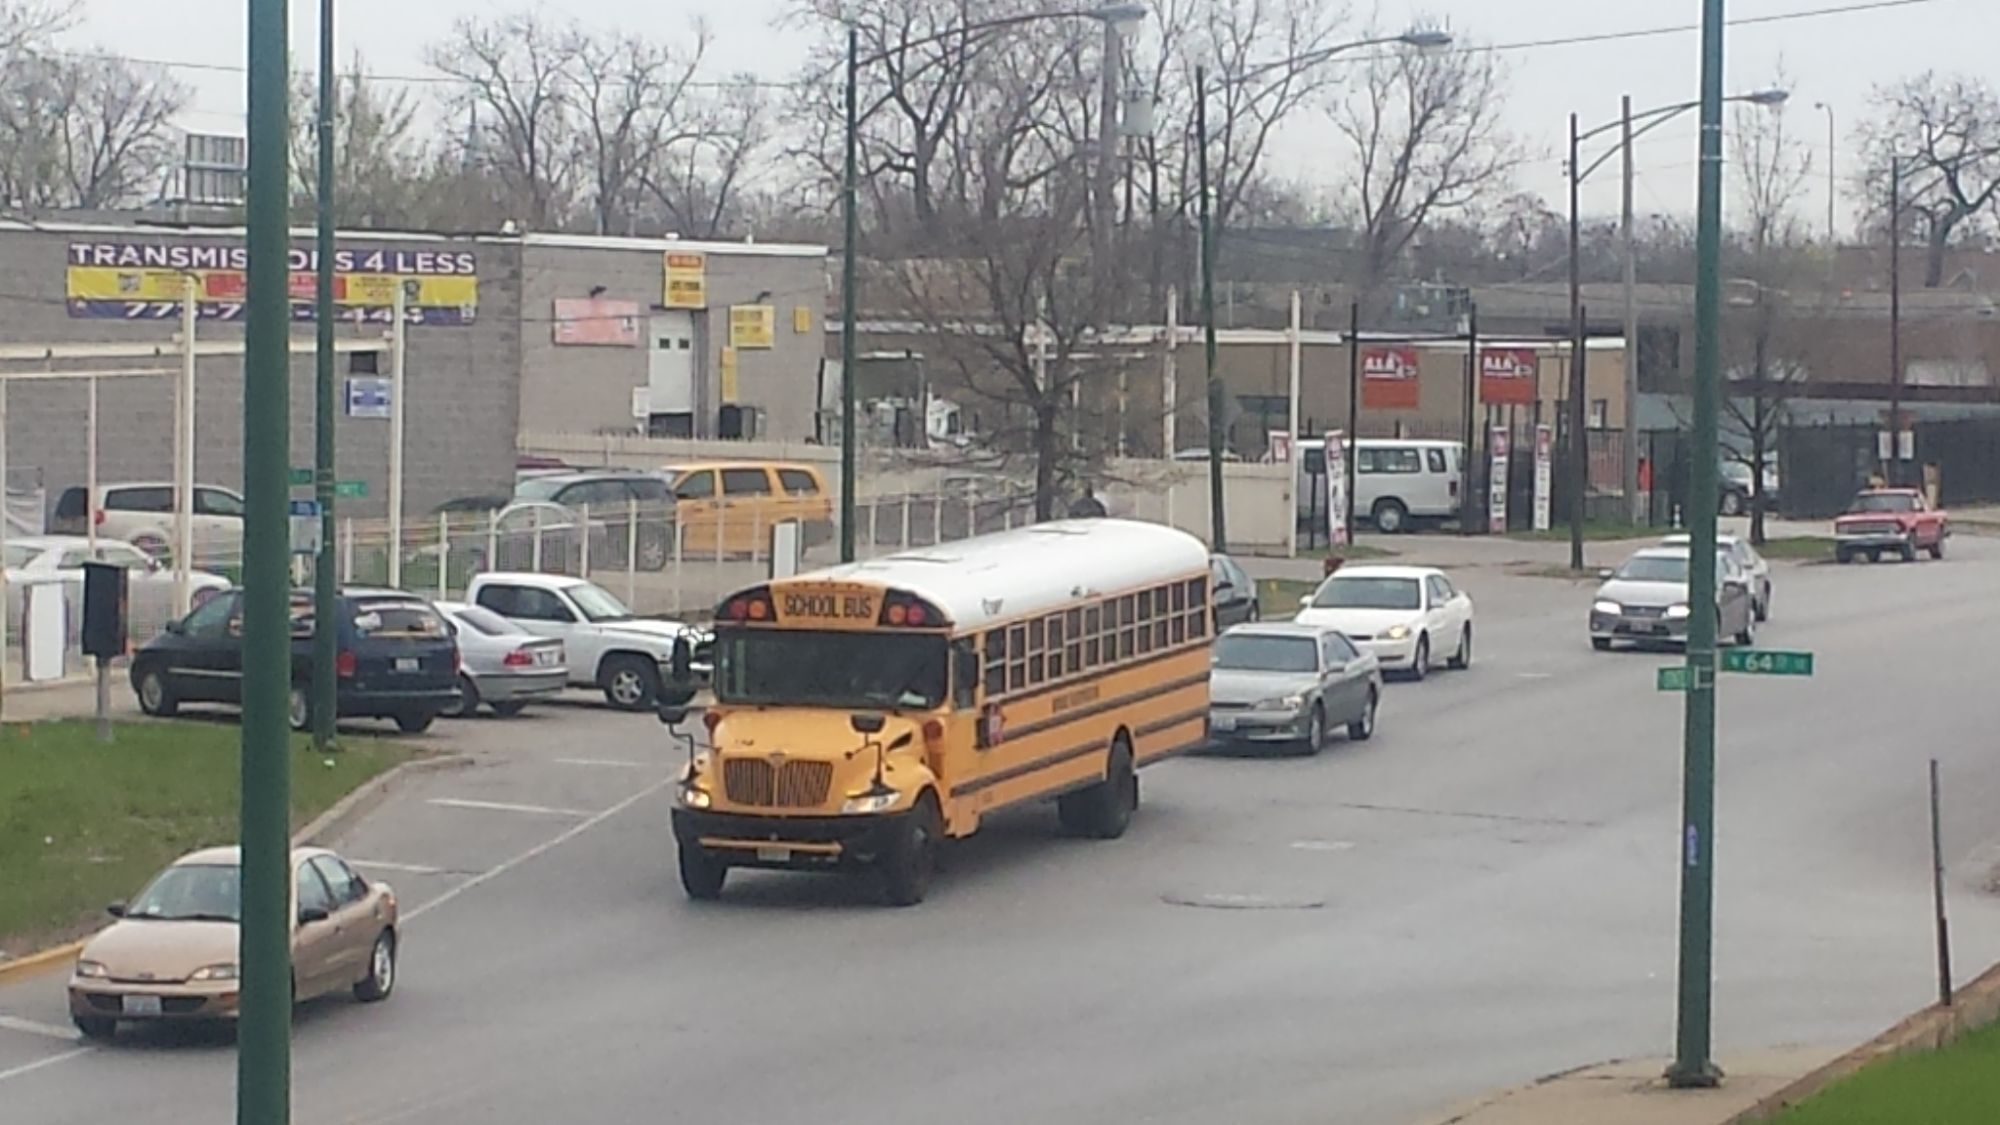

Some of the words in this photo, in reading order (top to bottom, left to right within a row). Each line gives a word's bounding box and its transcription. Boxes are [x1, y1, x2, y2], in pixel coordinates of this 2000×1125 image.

[364, 250, 385, 272] 4
[397, 252, 475, 273] LESS
[785, 593, 840, 617] SCHOOL
[844, 593, 872, 618] BUS
[1745, 653, 1773, 671] 64
